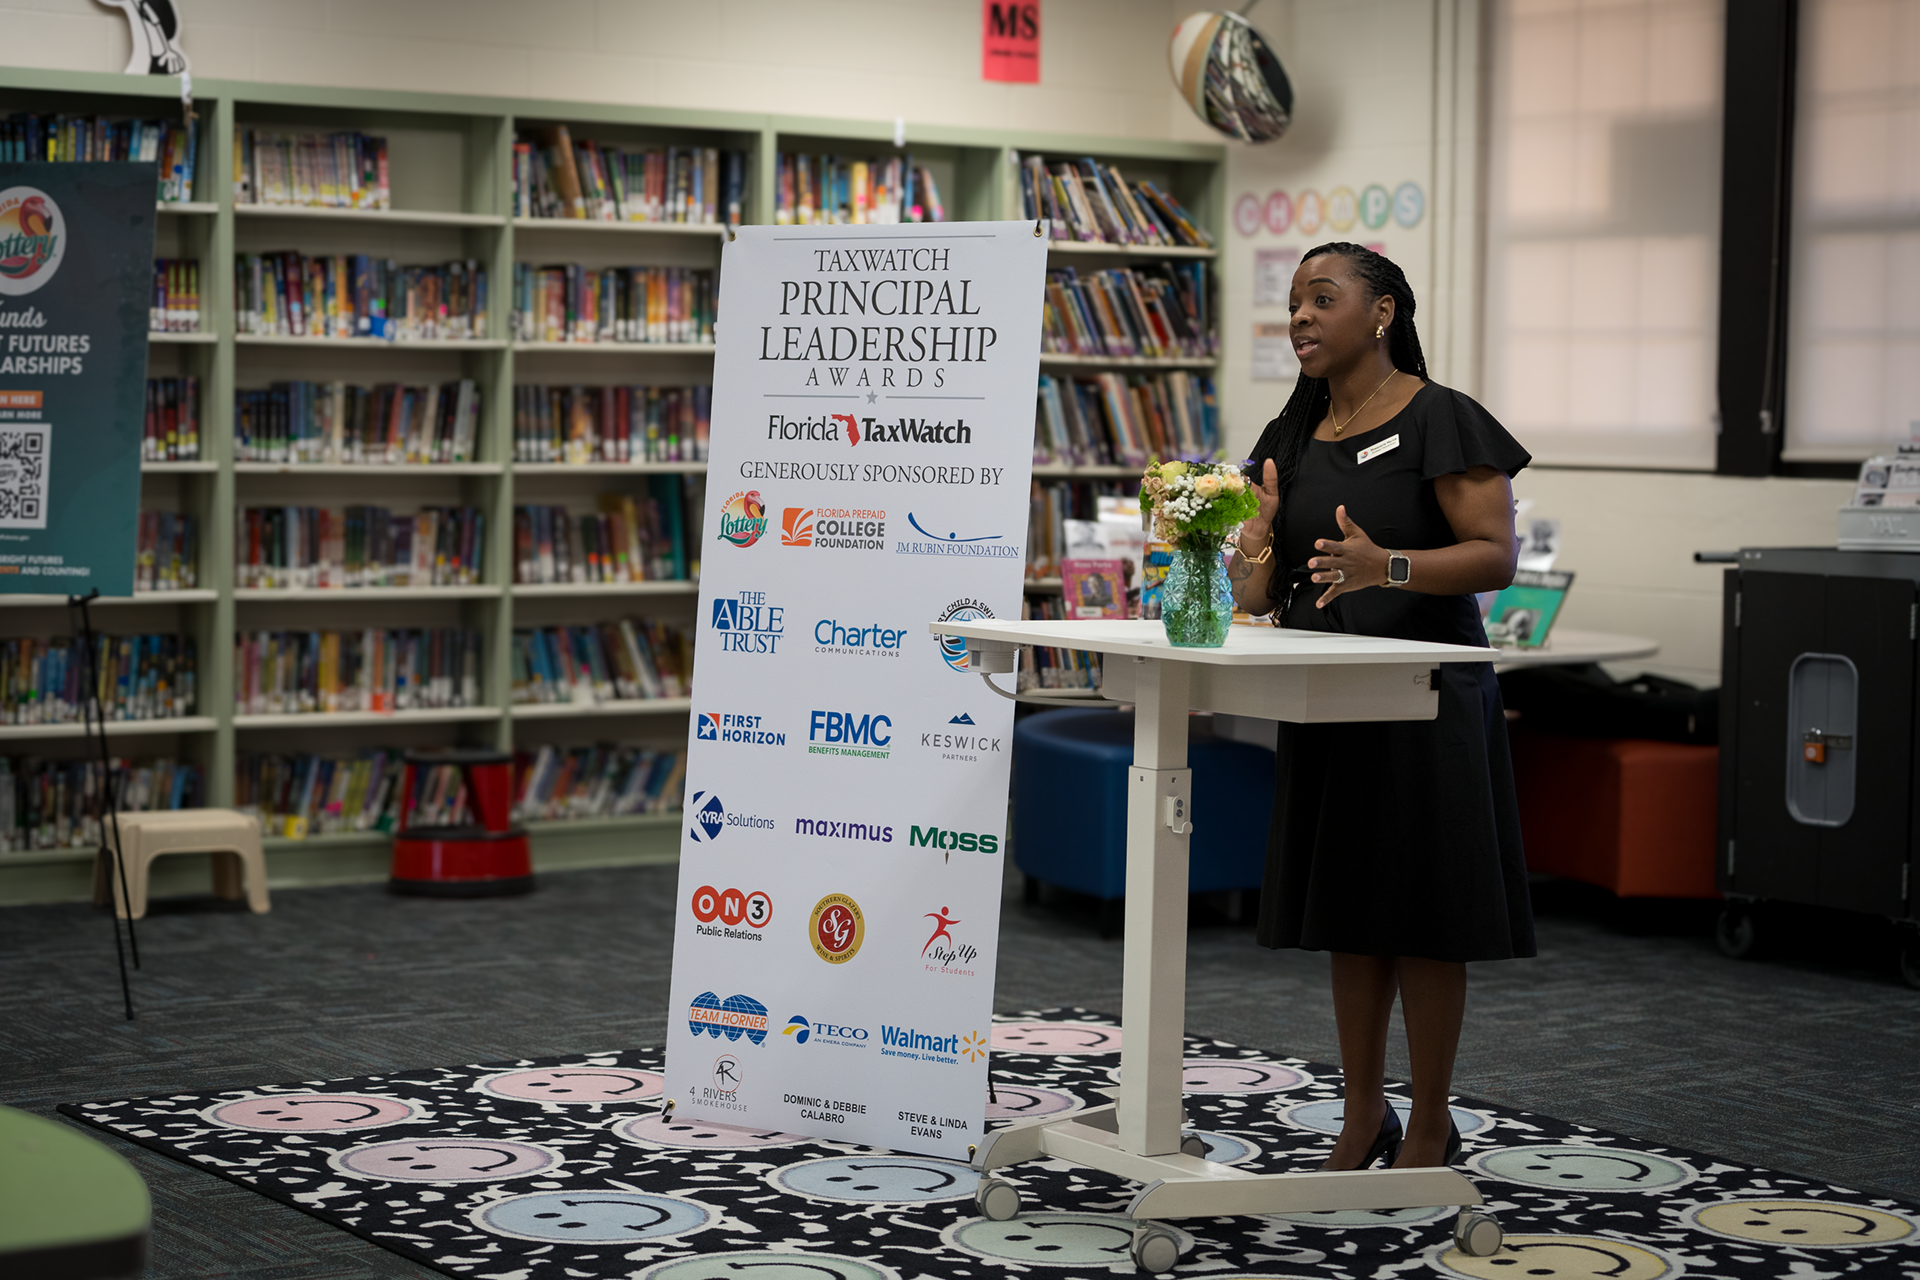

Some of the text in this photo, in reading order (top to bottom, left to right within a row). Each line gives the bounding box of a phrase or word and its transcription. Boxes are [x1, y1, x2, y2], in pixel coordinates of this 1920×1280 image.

[989, 4, 1038, 41] MS
[1236, 184, 1420, 235] CHAMPS
[0, 232, 57, 266] ottery
[814, 248, 950, 272] TAXWATCH
[779, 279, 981, 316] PRINCIPAL
[0, 306, 47, 328] unds
[8, 334, 91, 353] FUTURES
[759, 326, 997, 362] LEADERSHIP
[0, 356, 83, 375] ARSHIPS
[805, 367, 945, 388] AWARDS
[768, 414, 971, 444] Florida TaxWatch
[740, 461, 1004, 486] GENEROUSLY SPONSORED BY
[720, 491, 745, 513] FLORIDA
[817, 508, 886, 520] FLORIDA PREPAID
[717, 512, 768, 542] Lottery
[816, 520, 885, 537] COLLEGE
[815, 537, 884, 550] FOUNDATION
[896, 542, 1019, 557] JM RUBIN FOUNDATION
[0, 554, 26, 564] RIGHT
[739, 591, 766, 605] THE
[947, 598, 970, 612] CHILD
[712, 600, 785, 633] ABLE
[720, 632, 781, 654] TRUST
[815, 619, 907, 649] Charter
[815, 646, 900, 658] COMMUNICATIONS
[723, 714, 762, 729] FIRST
[809, 710, 892, 747] FBMC
[722, 729, 786, 746] HORIZON
[921, 733, 1001, 752] KESWICK
[808, 746, 890, 760] BENEFITS MANAGEMENT
[942, 753, 978, 762] PARTNERS
[726, 812, 775, 830] Solutions
[795, 817, 893, 843] maximus
[814, 896, 841, 916] SOUTHERN
[696, 924, 763, 942] Public Relations
[816, 944, 829, 959] WINE
[835, 948, 856, 961] SPIRITS
[928, 944, 977, 966] Step Up
[925, 964, 975, 977] For Students
[690, 1008, 767, 1029] TEAM HORNER
[813, 1023, 869, 1040] TECO
[881, 1025, 958, 1054] Walmart
[881, 1047, 959, 1065] Save money. Live better.
[689, 1086, 737, 1102] 4 RIVERS
[691, 1097, 748, 1112] SMOKEHOUSE
[784, 1094, 866, 1114] DOMINIC & DEBBIE
[801, 1109, 845, 1124] CALABRO
[898, 1111, 968, 1130] STEVE & LINDA
[911, 1126, 942, 1139] EVANS
